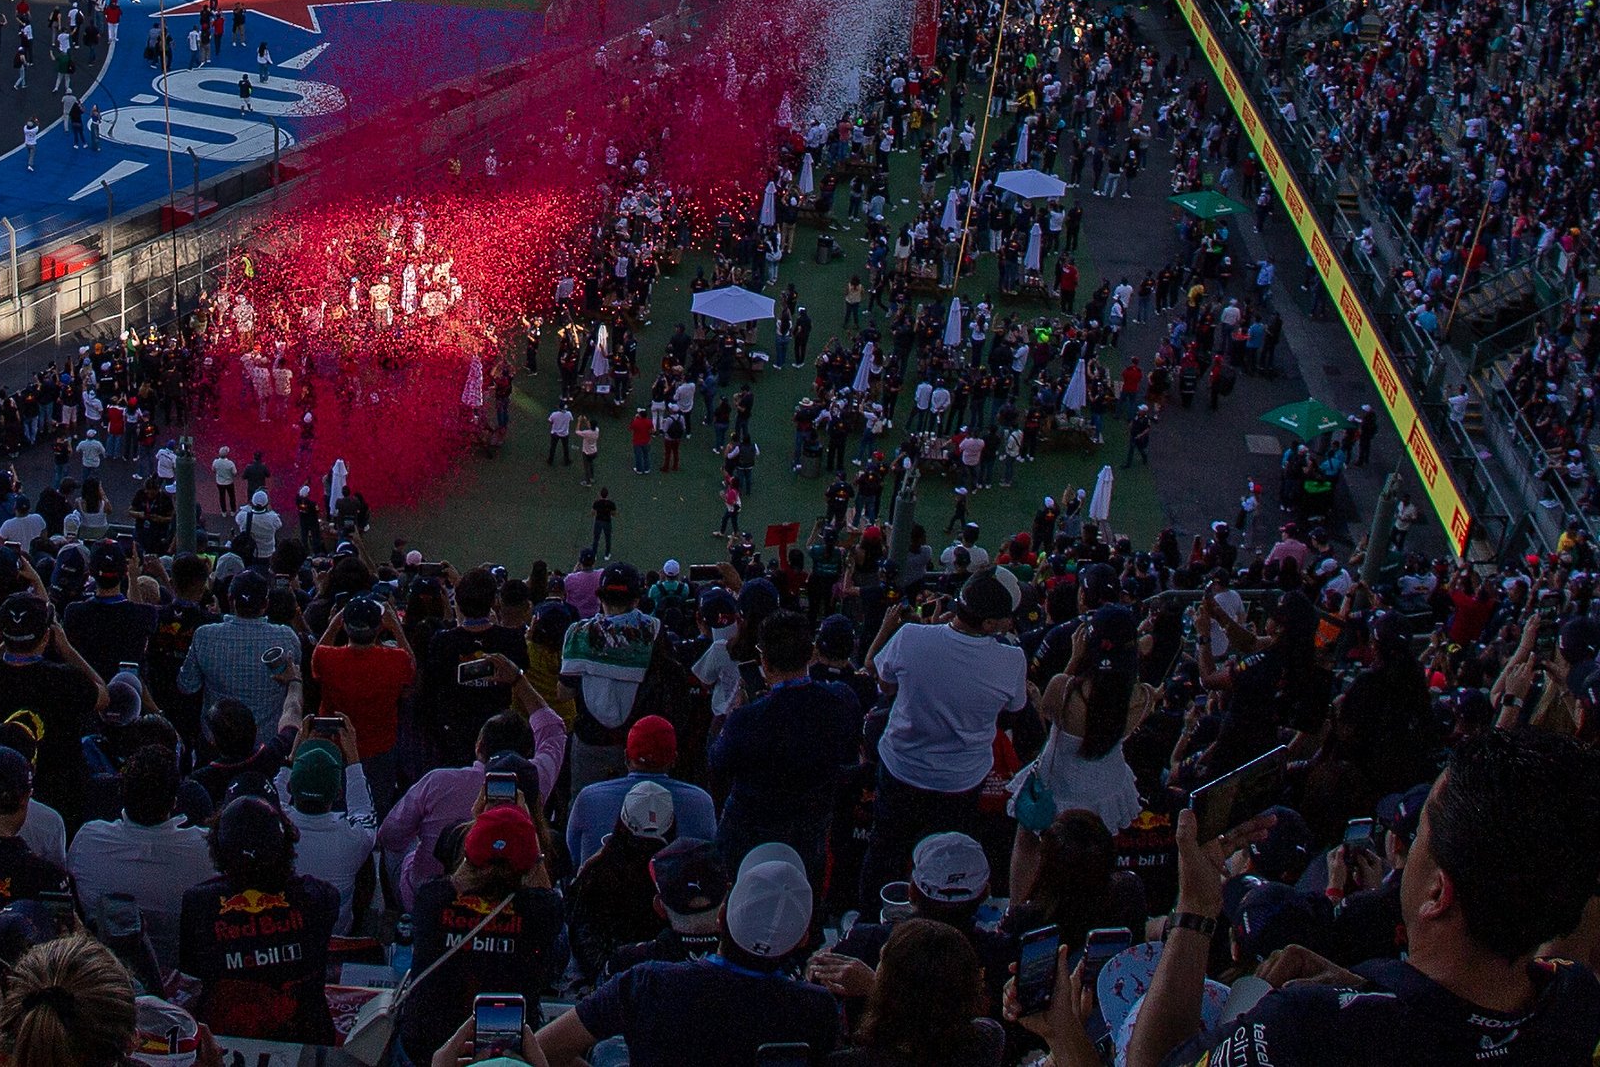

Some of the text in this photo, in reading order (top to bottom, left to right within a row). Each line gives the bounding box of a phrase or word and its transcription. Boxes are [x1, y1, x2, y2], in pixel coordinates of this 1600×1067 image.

[1340, 284, 1363, 340] PIRELLI
[1373, 346, 1399, 409] PIRELLI
[1408, 417, 1439, 490] PIRELLI
[213, 910, 304, 942] Red Bull
[681, 934, 719, 944] HONDA
[225, 946, 280, 971] Mobil
[165, 1025, 181, 1054] 1
